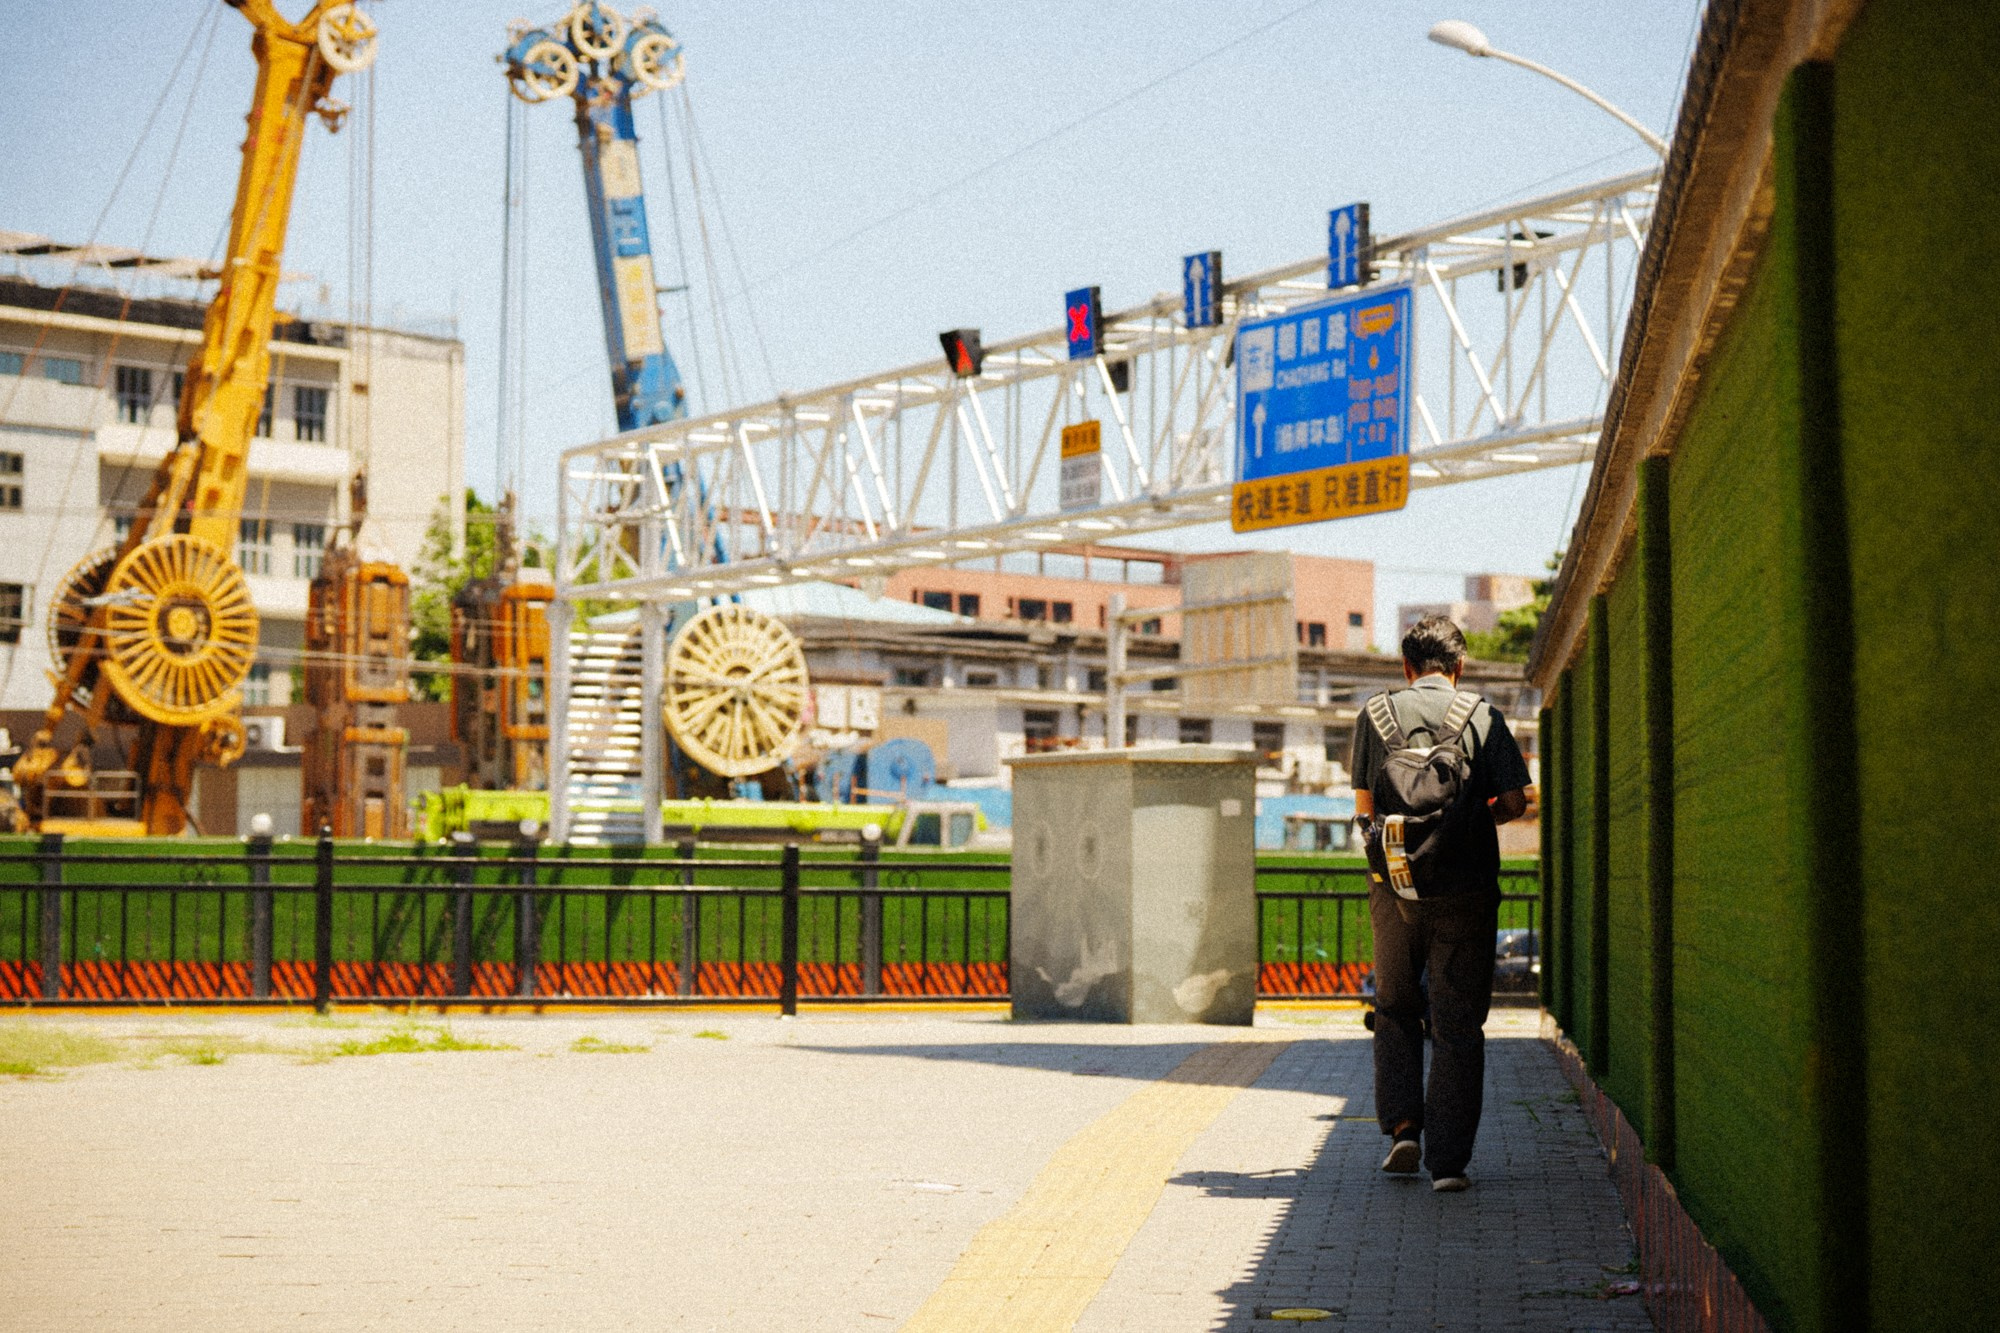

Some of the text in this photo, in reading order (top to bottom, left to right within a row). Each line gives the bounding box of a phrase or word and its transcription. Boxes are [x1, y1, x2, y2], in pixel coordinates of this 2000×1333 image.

[1238, 464, 1402, 523] 快速车道 只准直行
